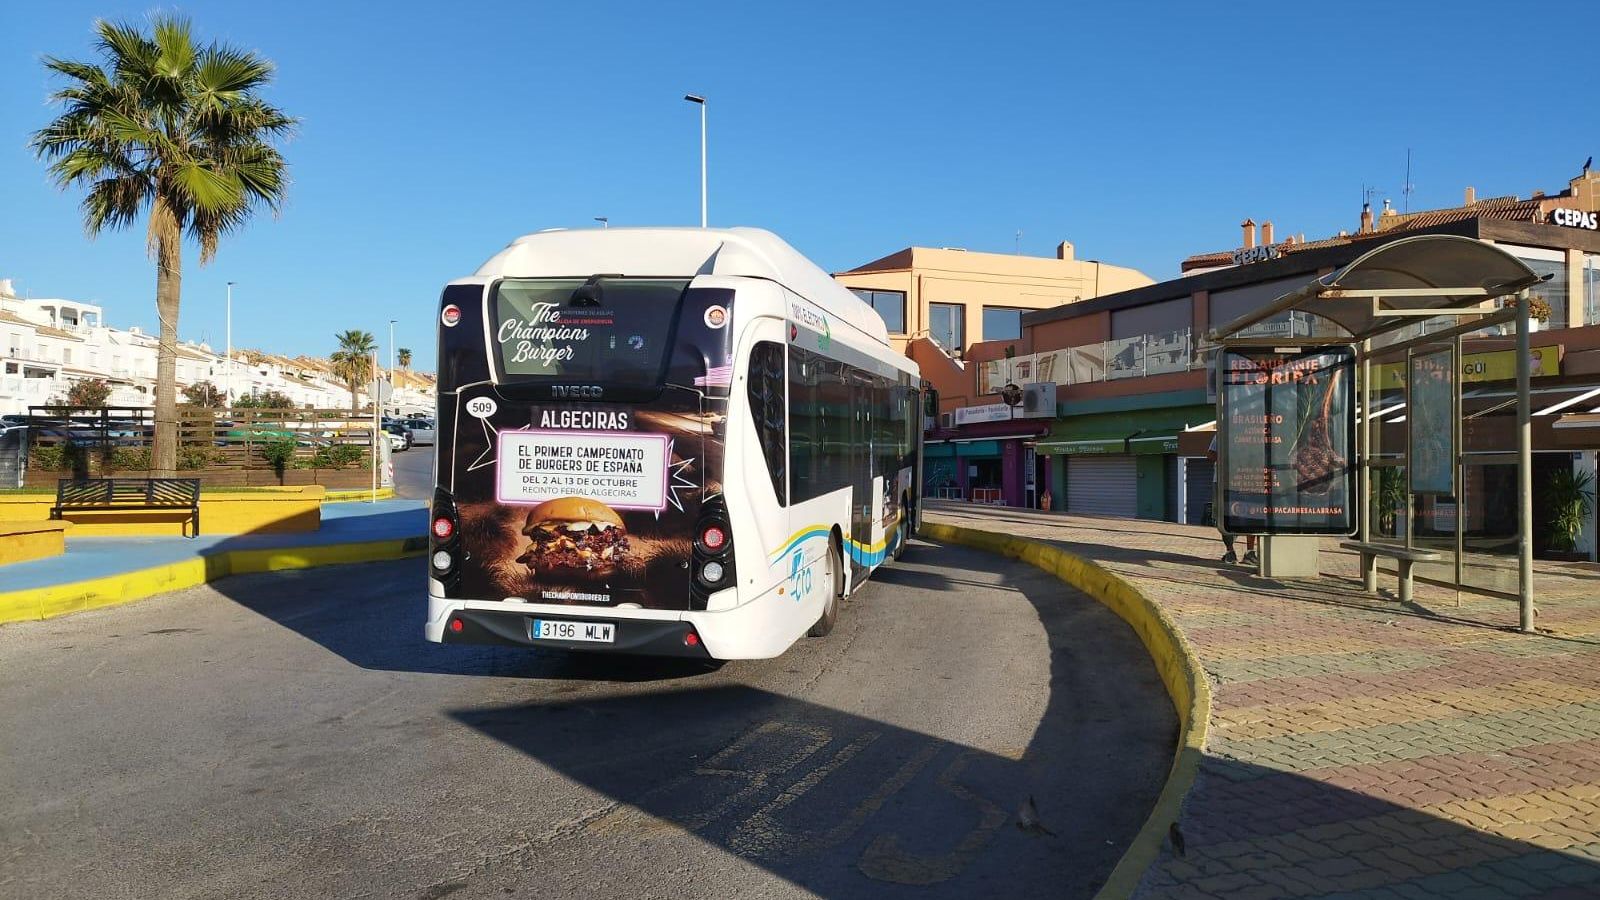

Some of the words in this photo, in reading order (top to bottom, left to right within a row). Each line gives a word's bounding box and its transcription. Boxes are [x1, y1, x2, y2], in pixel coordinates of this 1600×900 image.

[1554, 208, 1597, 230] CEPAS
[1233, 246, 1278, 265] CEPAS
[530, 302, 560, 326] The
[498, 318, 590, 343] Champions
[513, 341, 575, 366] Burger
[1231, 359, 1319, 371] RESTAURANTE
[1231, 370, 1319, 385] FLORIPA
[551, 385, 604, 399] IVECO
[472, 402, 493, 414] 509
[542, 412, 628, 430] ALGECIRAS
[518, 446, 531, 457] EL
[534, 447, 573, 459] PRIMER
[577, 447, 644, 460] CAMPEONATO
[518, 458, 532, 471] DE
[535, 459, 582, 471] BURGERS
[586, 460, 600, 472] DE
[603, 459, 643, 473] ESPAÑA
[522, 476, 540, 484] DEL
[542, 477, 549, 485] 2
[551, 477, 561, 485] AL
[564, 477, 574, 486] 13
[576, 477, 589, 486] DE
[592, 478, 638, 488] OCTUBRE
[522, 486, 558, 495] RECINTO
[560, 487, 588, 496] FERIAL
[590, 488, 638, 497] ALGECIRAS
[542, 622, 575, 638] 3196
[585, 624, 611, 640] MLW
